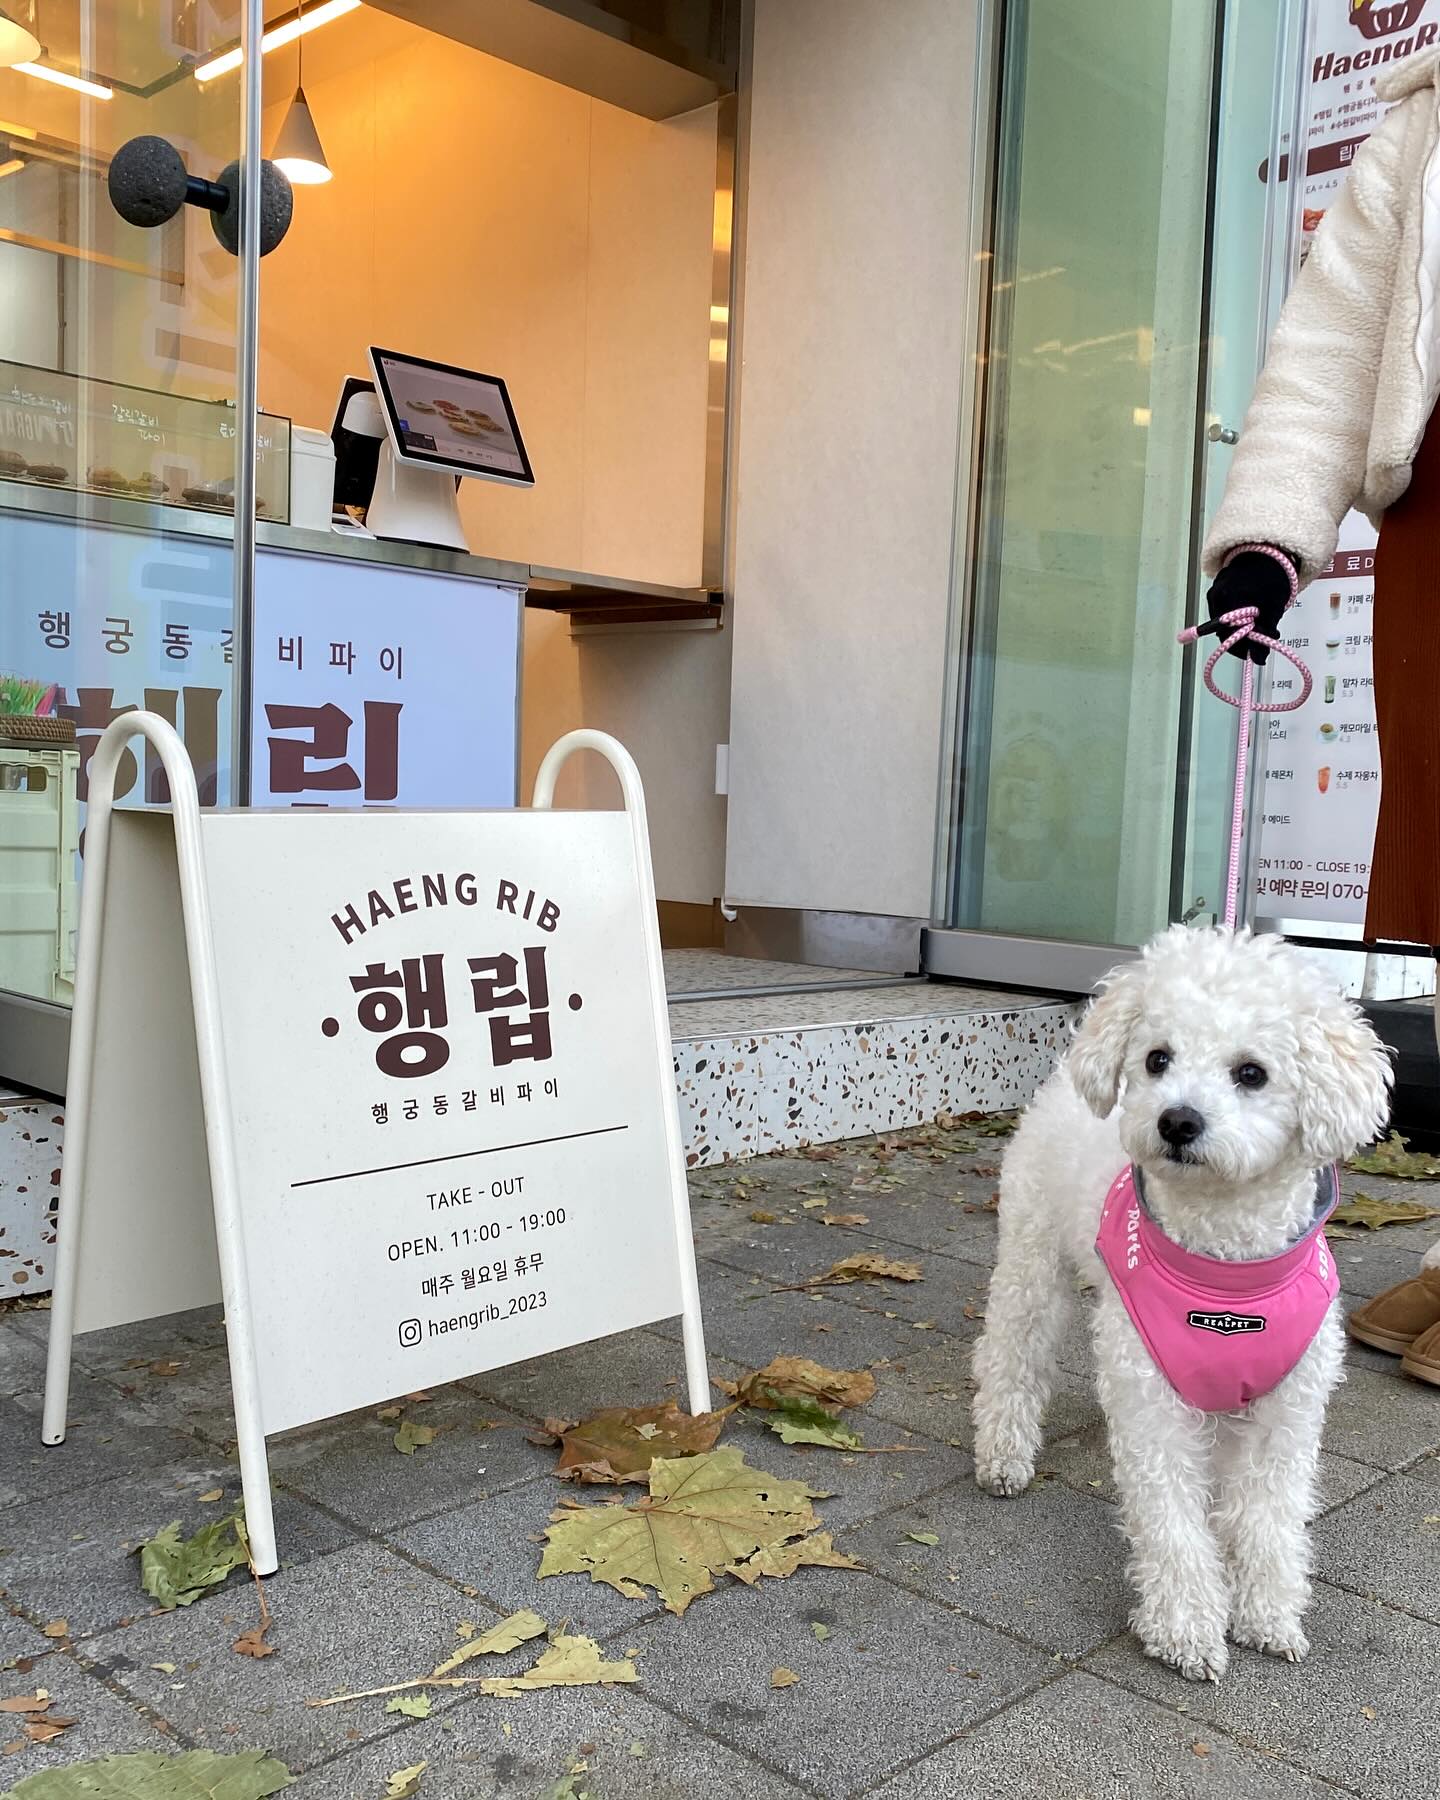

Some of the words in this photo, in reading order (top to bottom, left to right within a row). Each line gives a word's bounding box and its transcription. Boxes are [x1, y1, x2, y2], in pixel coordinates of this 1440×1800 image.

[1312, 22, 1440, 83] HaengR
[1345, 635, 1361, 646] 크림
[1258, 858, 1272, 869] EN
[1274, 859, 1303, 871] 11:00
[1316, 861, 1351, 873] CLOSE
[331, 873, 478, 945] HAENG
[496, 879, 561, 933] RIB
[1269, 879, 1299, 897] 예약
[1300, 880, 1330, 900] 문의
[349, 946, 552, 1079] 행립
[426, 1186, 473, 1211] TAKE
[491, 1176, 525, 1198] OUT
[387, 1235, 444, 1261] OPEN.
[450, 1222, 501, 1248] 11:00
[519, 1208, 566, 1233] 19:00
[421, 1275, 455, 1298] 매주
[461, 1260, 508, 1290] 월요일
[514, 1252, 544, 1277] 휴무
[428, 1290, 548, 1338] haengrib_2023
[1203, 1318, 1250, 1329] REALPET
